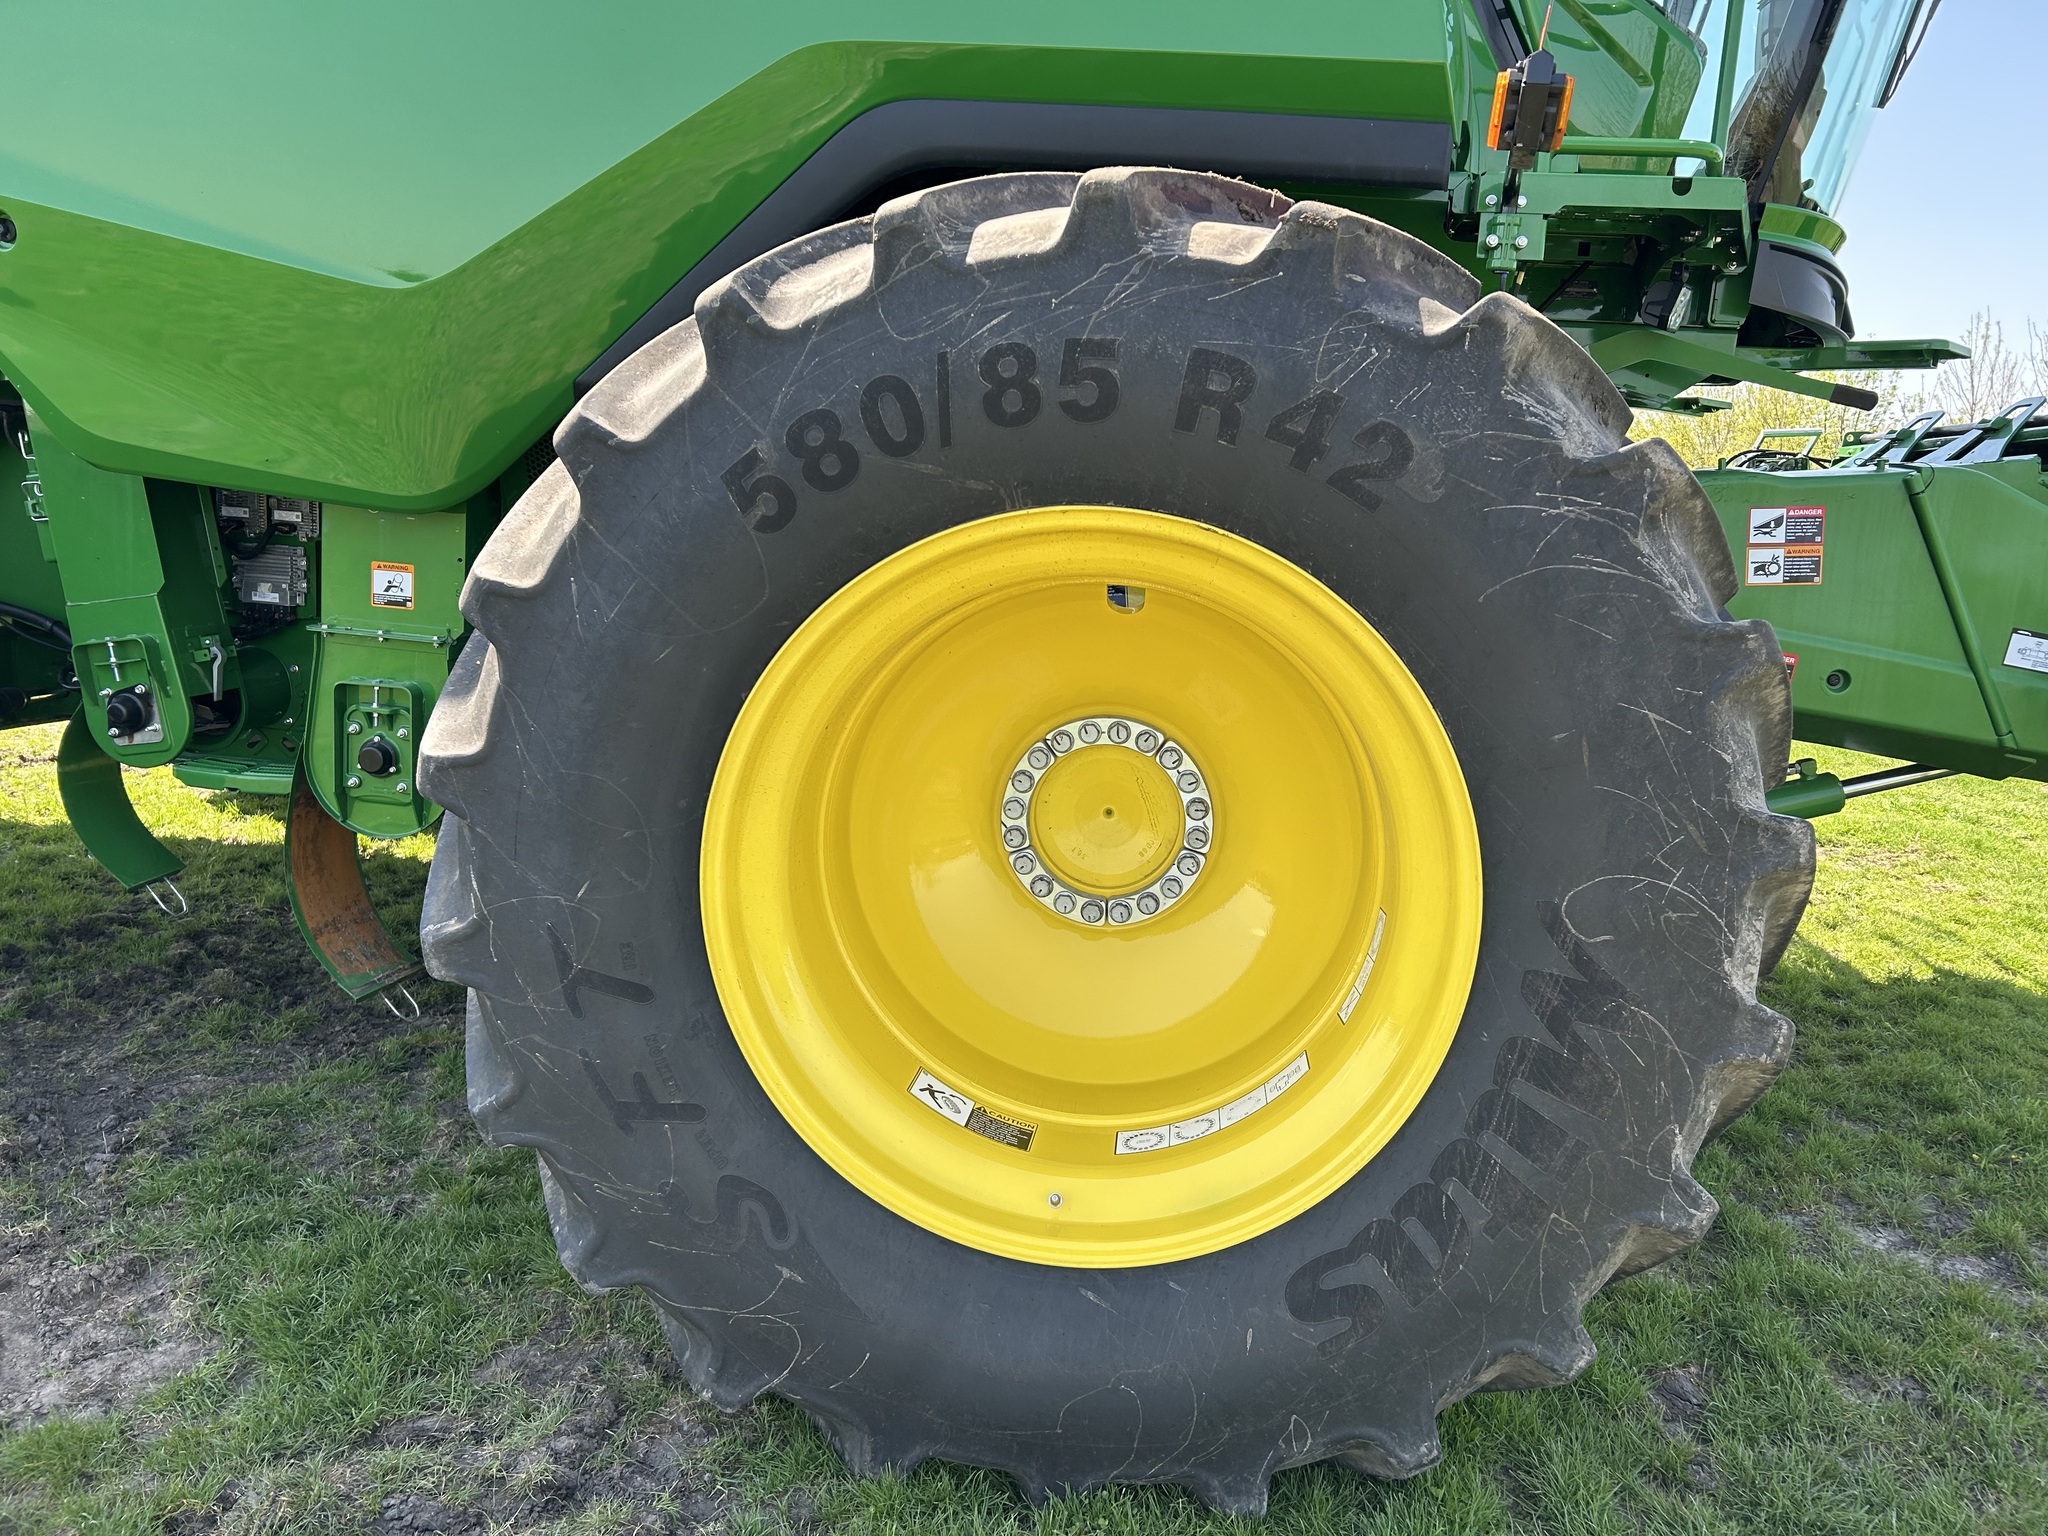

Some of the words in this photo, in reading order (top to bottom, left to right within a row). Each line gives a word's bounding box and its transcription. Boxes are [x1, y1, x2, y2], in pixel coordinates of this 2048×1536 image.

[719, 338, 1122, 535] 580/85
[382, 563, 408, 571] WARNING
[988, 1110, 1036, 1130] CAUTION
